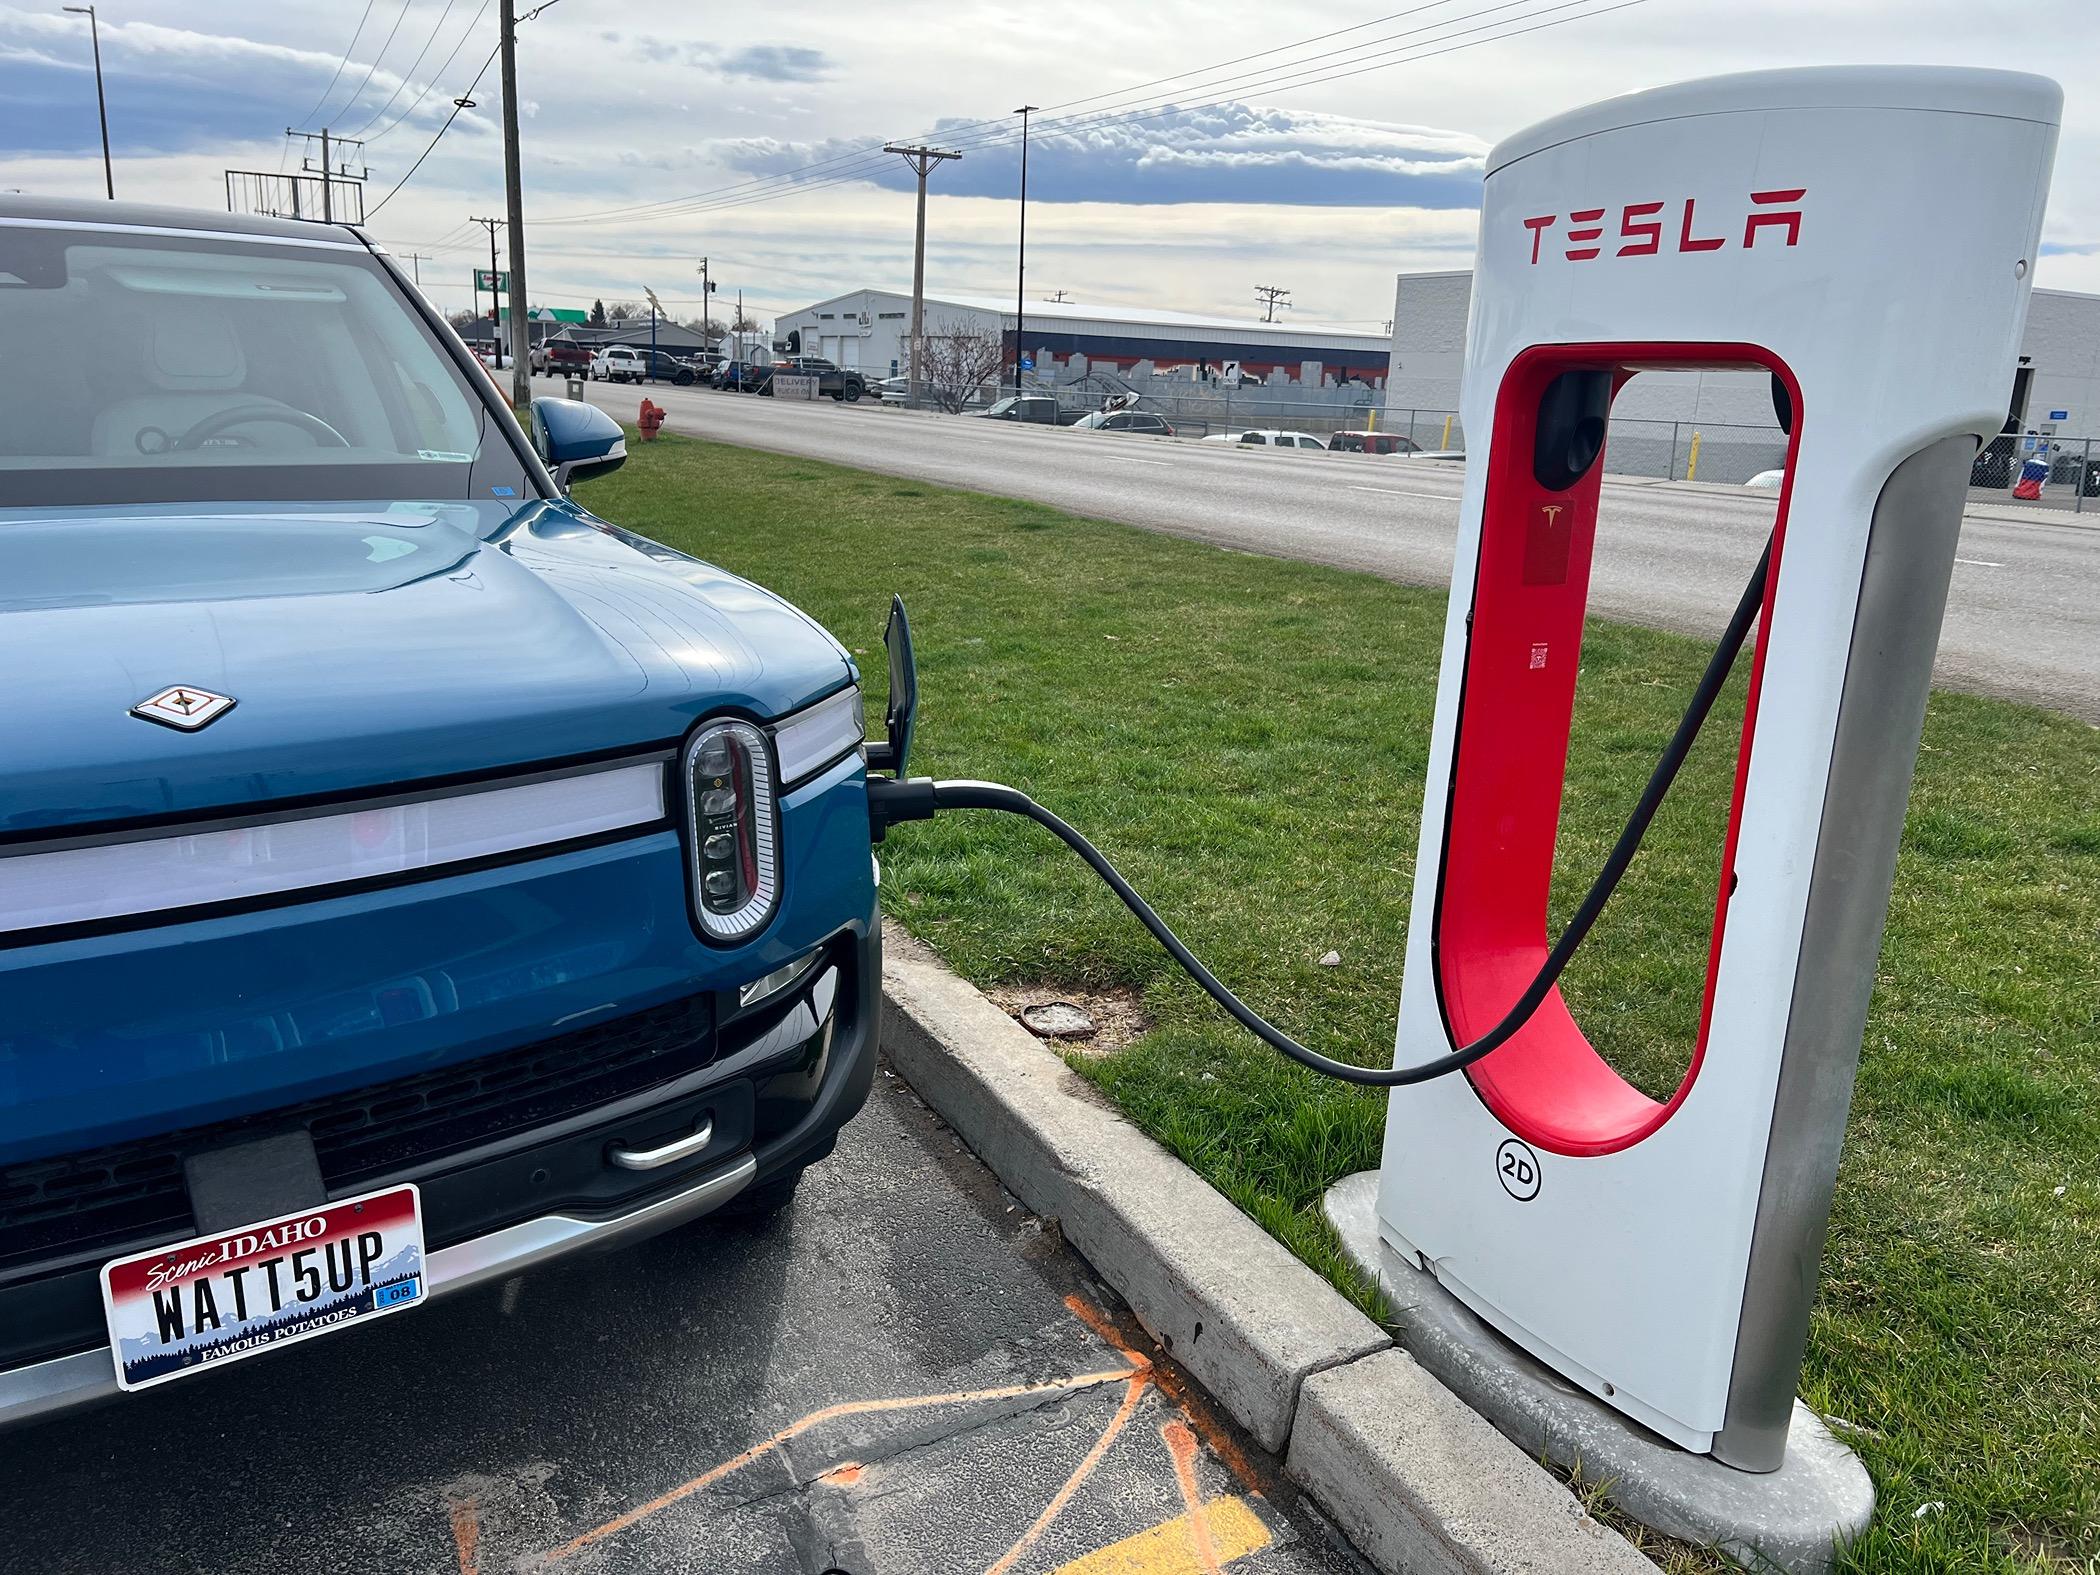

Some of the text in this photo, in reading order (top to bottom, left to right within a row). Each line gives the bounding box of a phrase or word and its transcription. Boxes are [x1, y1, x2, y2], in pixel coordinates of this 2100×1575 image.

[1523, 188, 1807, 265] TESLA
[1502, 1152, 1534, 1184] 2D
[145, 1216, 327, 1291] Scenic IDAHO
[152, 1231, 383, 1345] WATT5UP
[390, 1286, 411, 1300] 08
[200, 1306, 358, 1362] FAMOUS POTATOES
